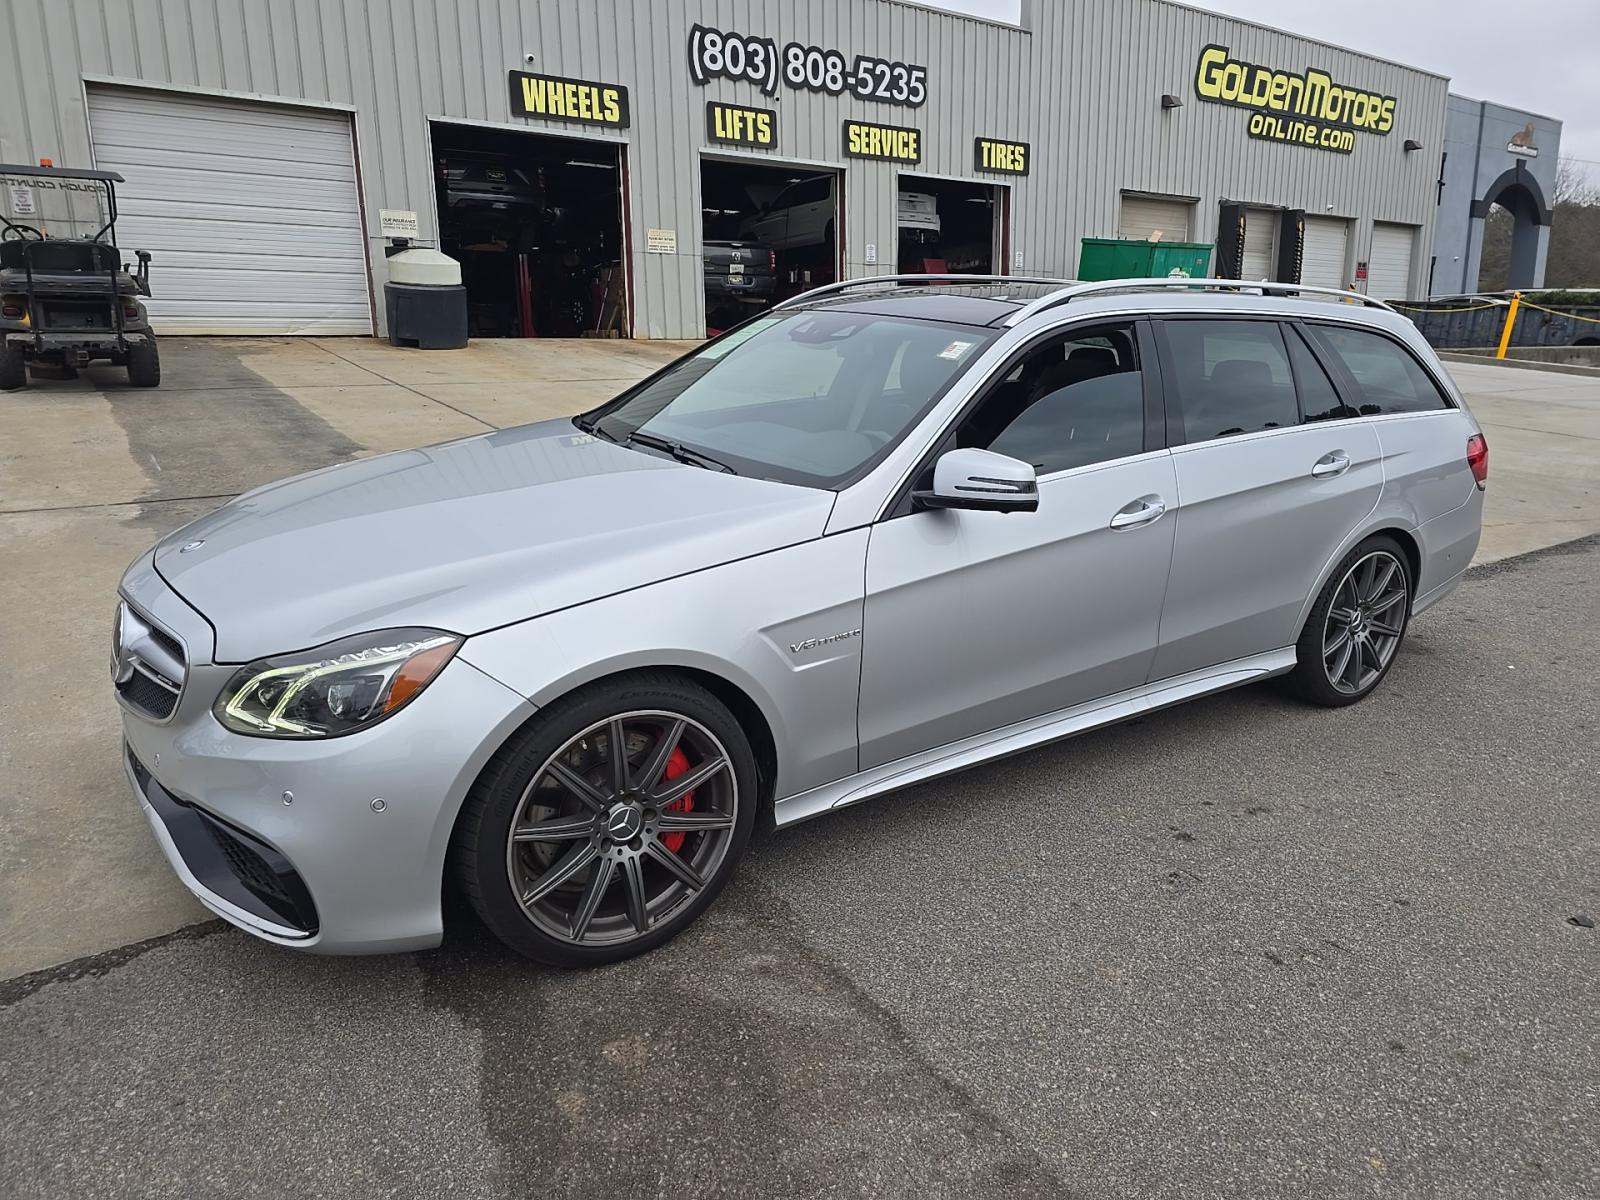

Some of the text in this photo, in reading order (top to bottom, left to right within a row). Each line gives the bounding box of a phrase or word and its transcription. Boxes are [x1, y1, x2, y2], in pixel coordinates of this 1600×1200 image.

[692, 30, 926, 103] (803) 808-5235
[521, 77, 620, 122] WHEELS
[714, 106, 771, 143] LIFTS
[848, 124, 917, 160] SERVICE
[981, 141, 1025, 171] TIRES
